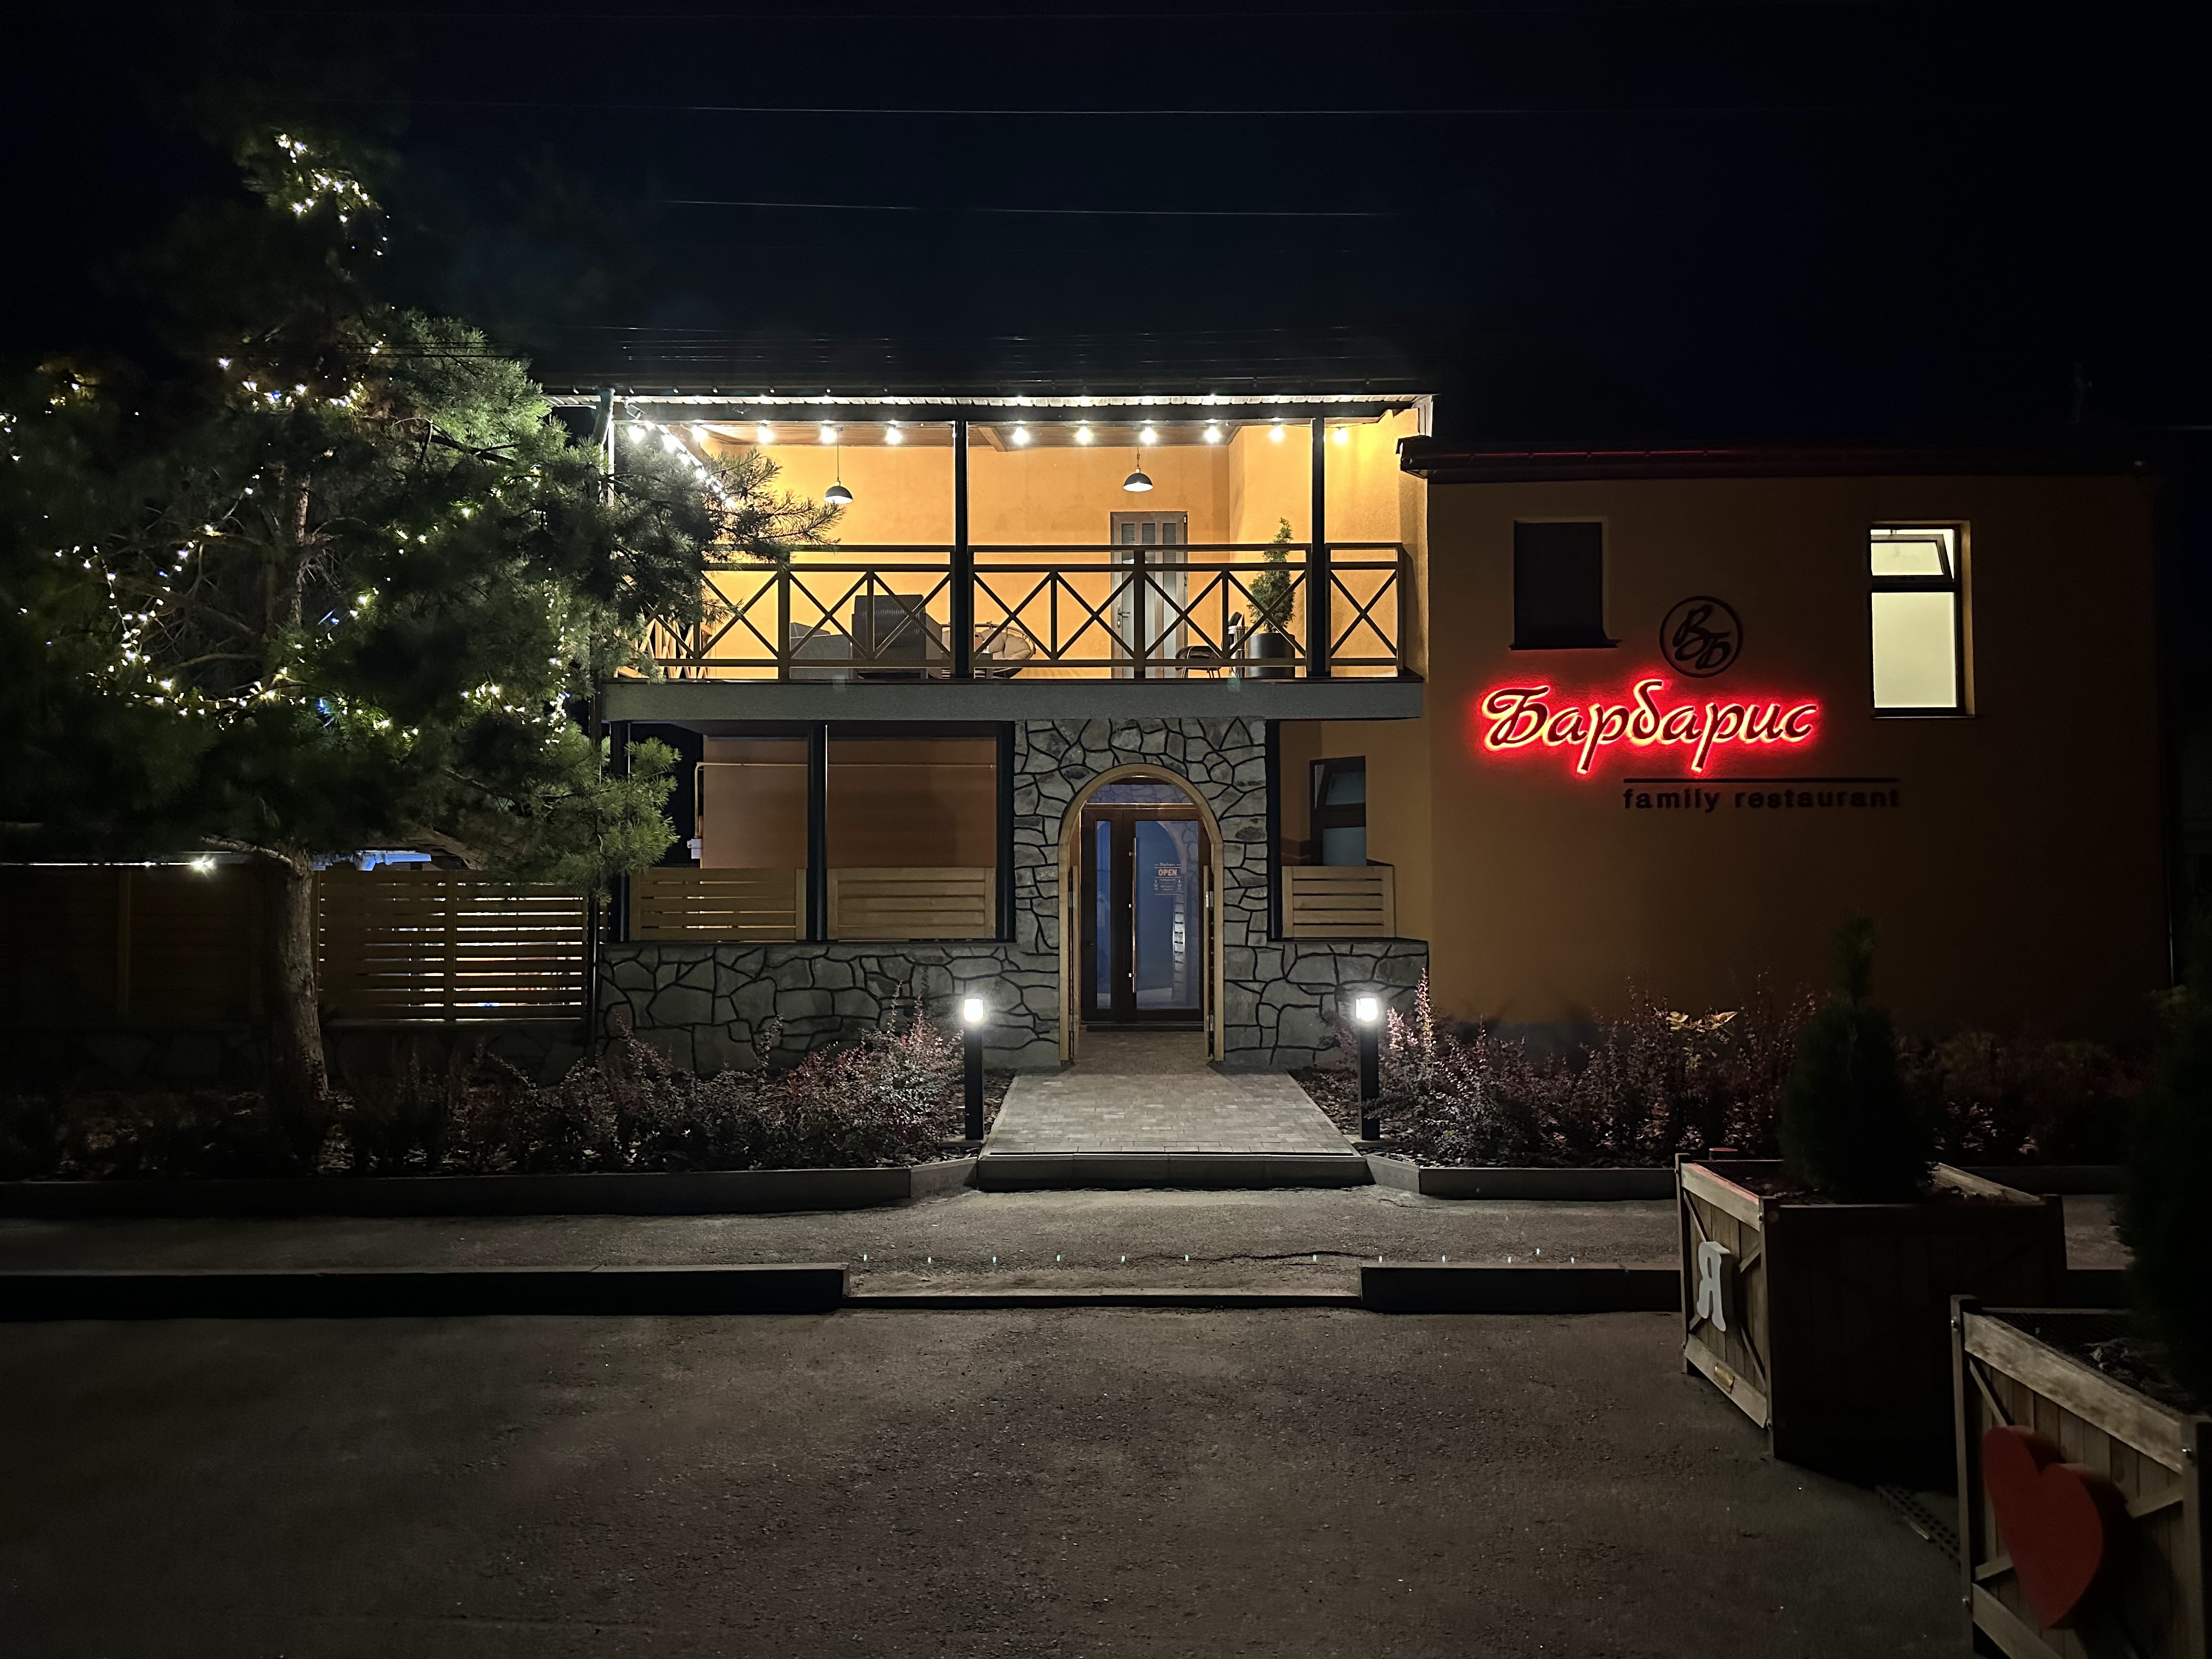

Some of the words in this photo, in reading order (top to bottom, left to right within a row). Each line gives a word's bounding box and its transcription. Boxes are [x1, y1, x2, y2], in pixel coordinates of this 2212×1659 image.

[1482, 679, 1817, 774] Барбарис
[1623, 788, 1720, 812] family
[1735, 788, 1900, 809] restaurant
[1158, 868, 1177, 877] OPEN
[1696, 1241, 1726, 1332] Я
